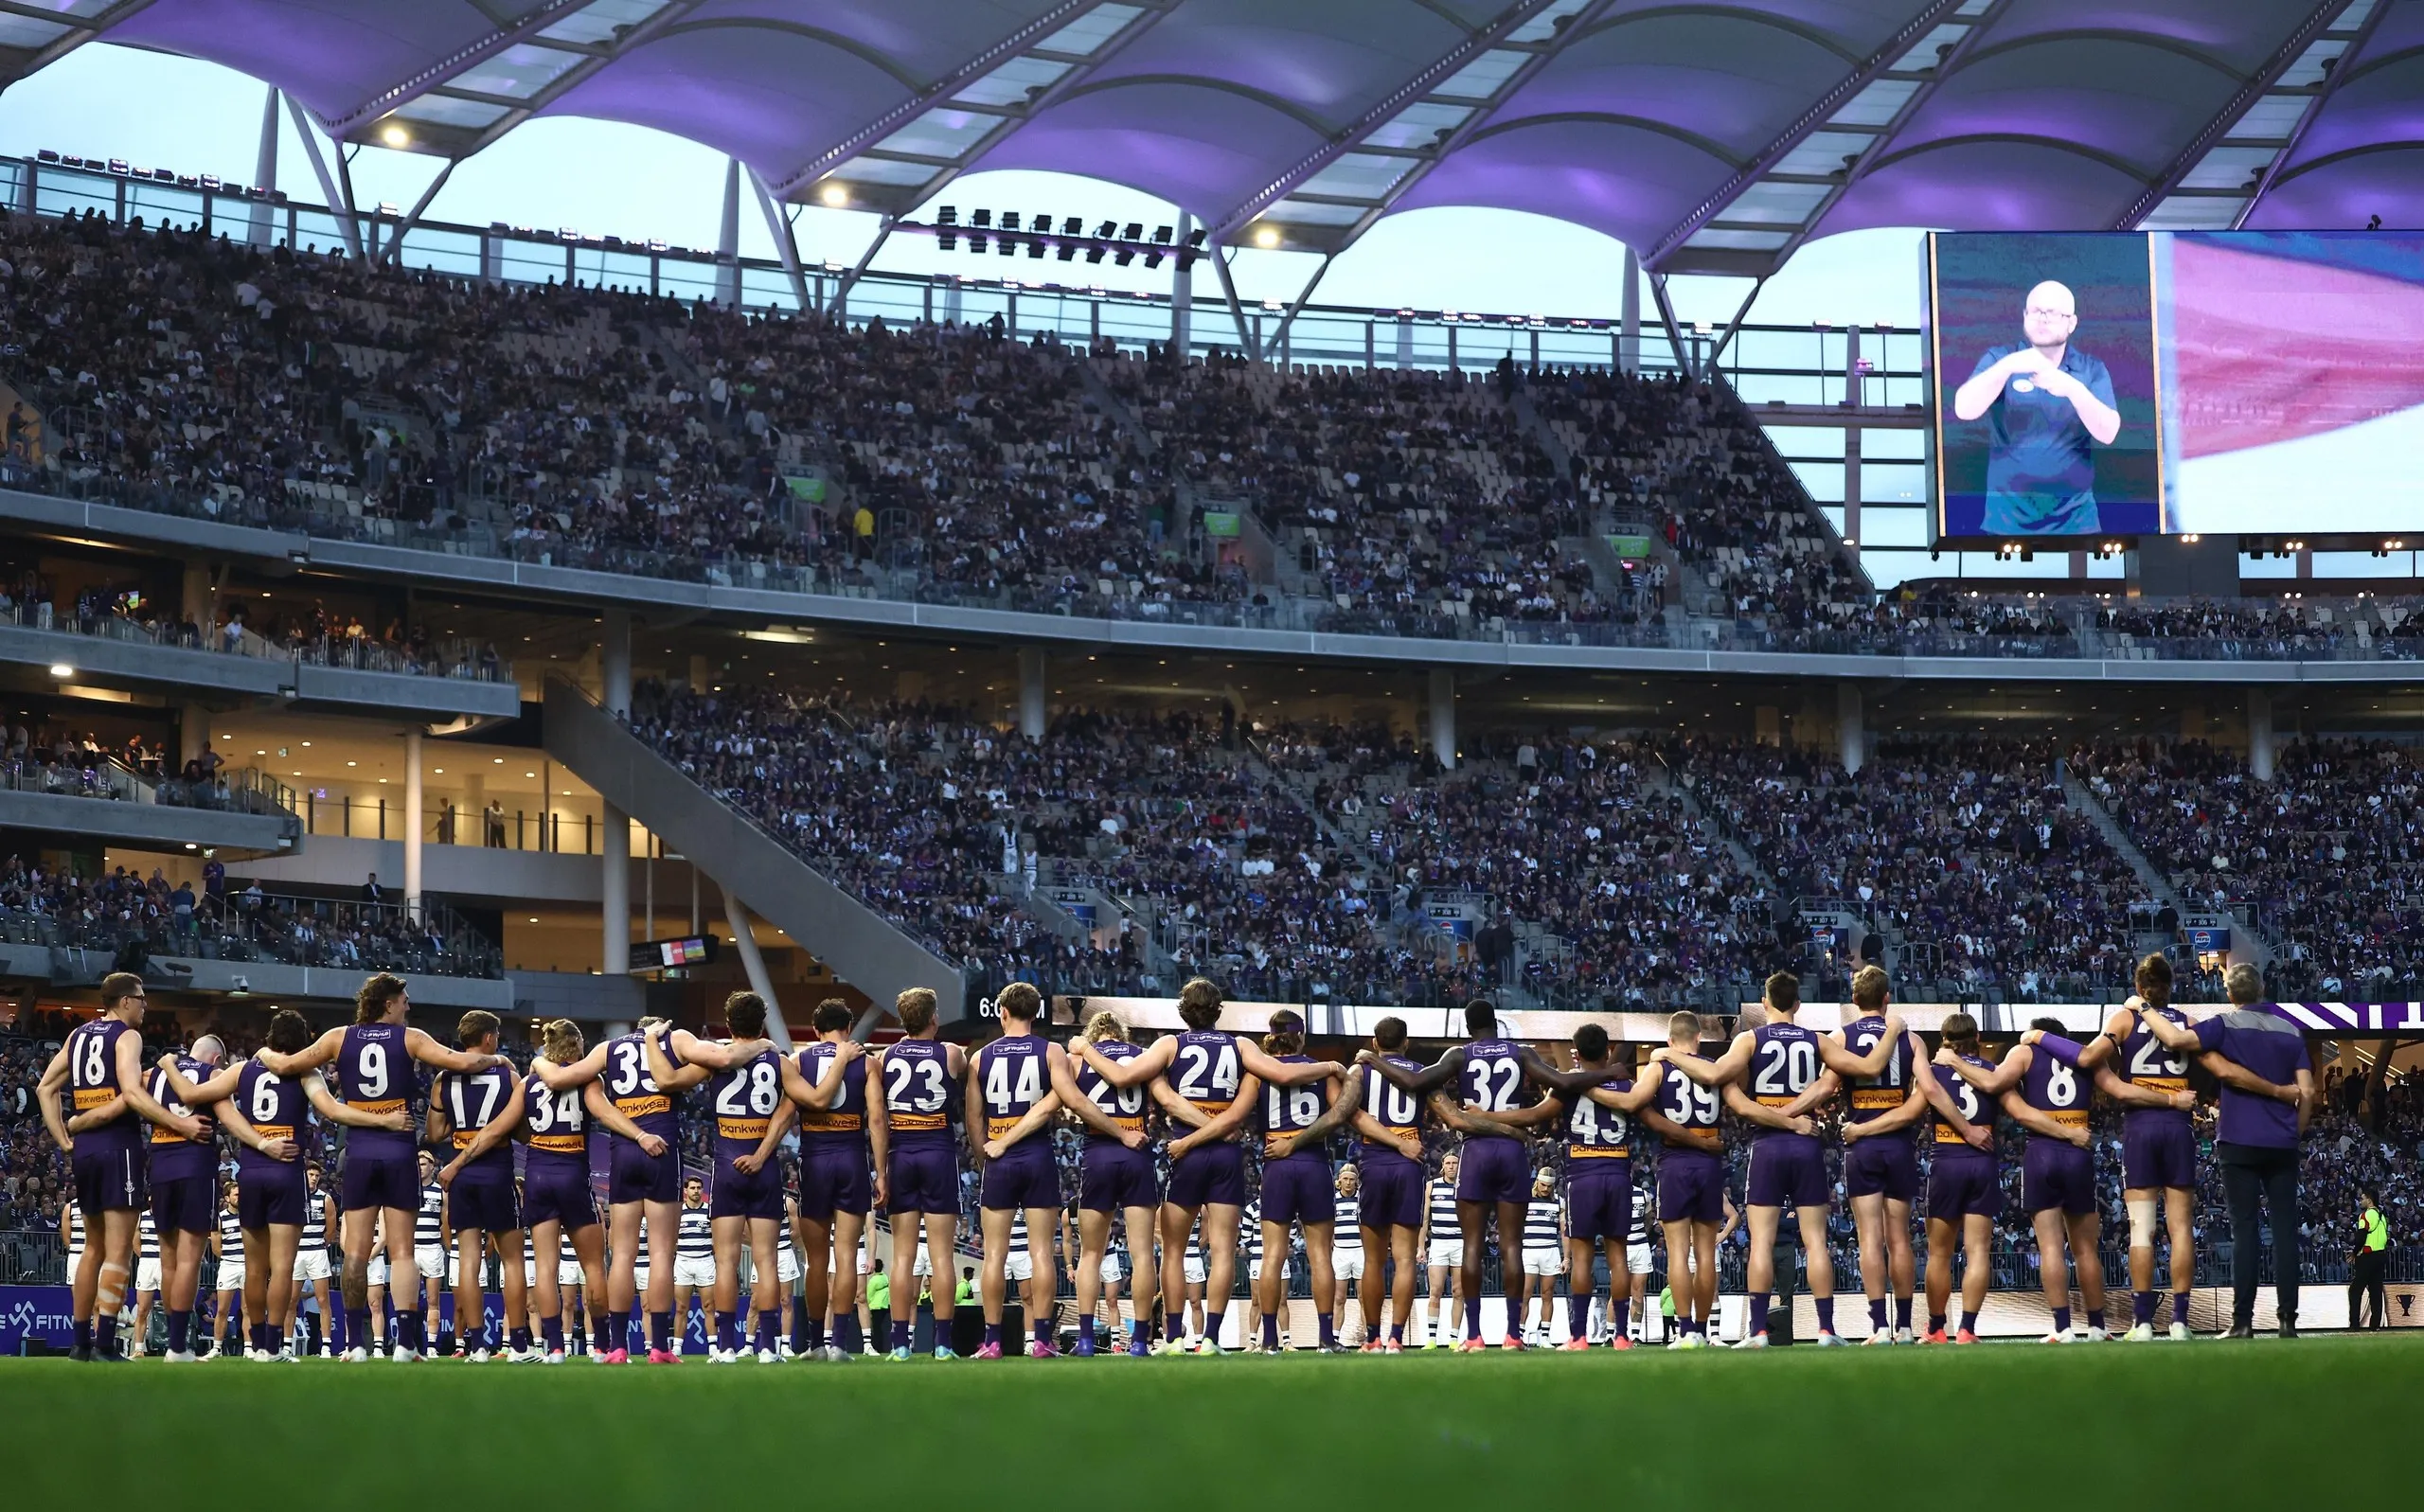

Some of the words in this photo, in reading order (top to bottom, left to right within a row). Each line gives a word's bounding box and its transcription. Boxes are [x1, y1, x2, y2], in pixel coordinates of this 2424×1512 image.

[72, 1032, 106, 1087] 18
[358, 1042, 389, 1098] 9
[611, 1041, 667, 1095] 35
[1178, 1044, 1239, 1099] 24
[1755, 1040, 1817, 1094] 20
[2130, 1021, 2189, 1075] 25
[252, 1071, 281, 1122] 6
[450, 1075, 502, 1129] 17
[528, 1080, 584, 1132] 34
[715, 1061, 779, 1116] 28
[885, 1058, 947, 1112] 23
[985, 1055, 1044, 1114] 44
[1268, 1080, 1321, 1130] 16
[1367, 1069, 1417, 1124] 10
[1463, 1057, 1521, 1112] 32
[1664, 1069, 1720, 1125] 39
[1853, 1094, 1903, 1104] bankwest
[1951, 1072, 1979, 1121] 3
[2046, 1057, 2077, 1107] 8
